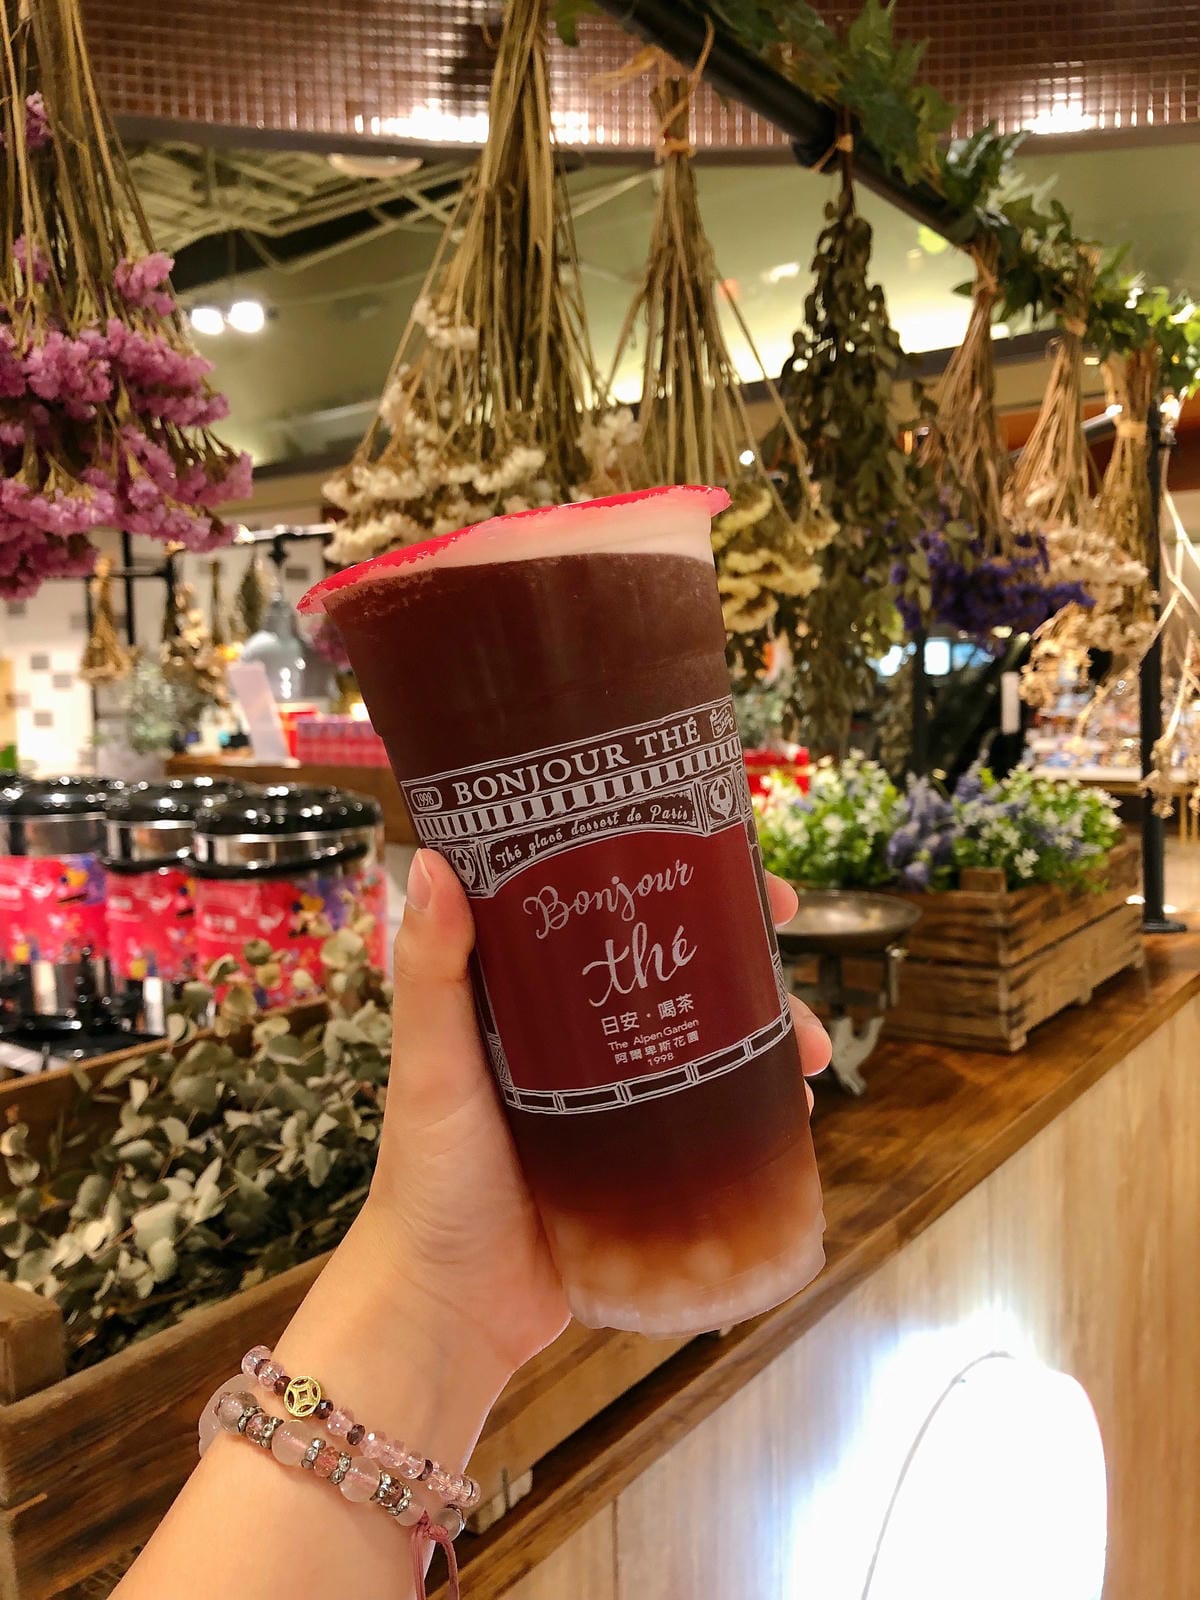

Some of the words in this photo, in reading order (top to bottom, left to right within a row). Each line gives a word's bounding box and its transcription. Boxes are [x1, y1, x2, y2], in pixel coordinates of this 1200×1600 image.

[452, 743, 630, 805] BONJOUR
[635, 716, 701, 759] THÉ
[495, 845, 522, 868] Thé
[528, 828, 563, 858] glacé
[571, 812, 620, 836] dessert
[626, 806, 642, 823] de
[650, 804, 688, 822] Paris
[522, 859, 694, 939] Bonjour
[581, 922, 698, 1007] thé
[607, 1041, 629, 1051] The
[633, 1031, 663, 1045] Alpen
[663, 1019, 700, 1036] Garden
[647, 1052, 674, 1066] 1998
